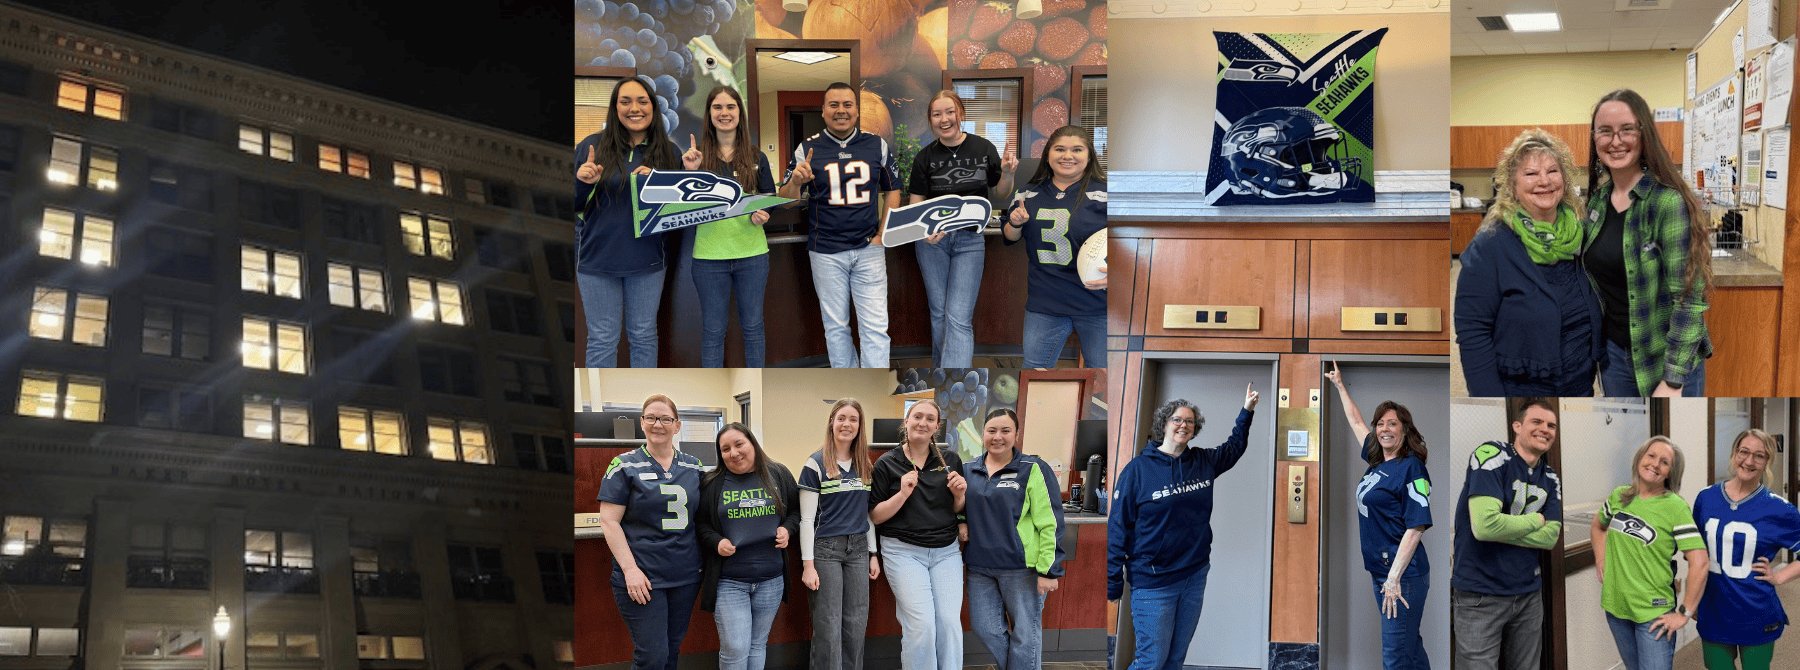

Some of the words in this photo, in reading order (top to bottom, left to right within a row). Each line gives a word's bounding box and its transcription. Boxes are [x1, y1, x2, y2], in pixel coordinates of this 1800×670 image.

[1312, 53, 1357, 97] Seattle
[1315, 66, 1370, 115] SEAHAWKS
[930, 155, 988, 169] SEATTLE
[823, 160, 871, 206] 12
[661, 211, 726, 230] SEAHAWKS
[671, 209, 713, 221] SEATTLE
[1035, 207, 1073, 266] 3
[338, 484, 444, 504] NATIONL
[722, 486, 778, 506] SEATTL
[1151, 480, 1211, 501] SEAHAWKS
[659, 483, 689, 530] 3
[727, 504, 776, 519] SEAHAWKS
[1704, 517, 1758, 579] 10
